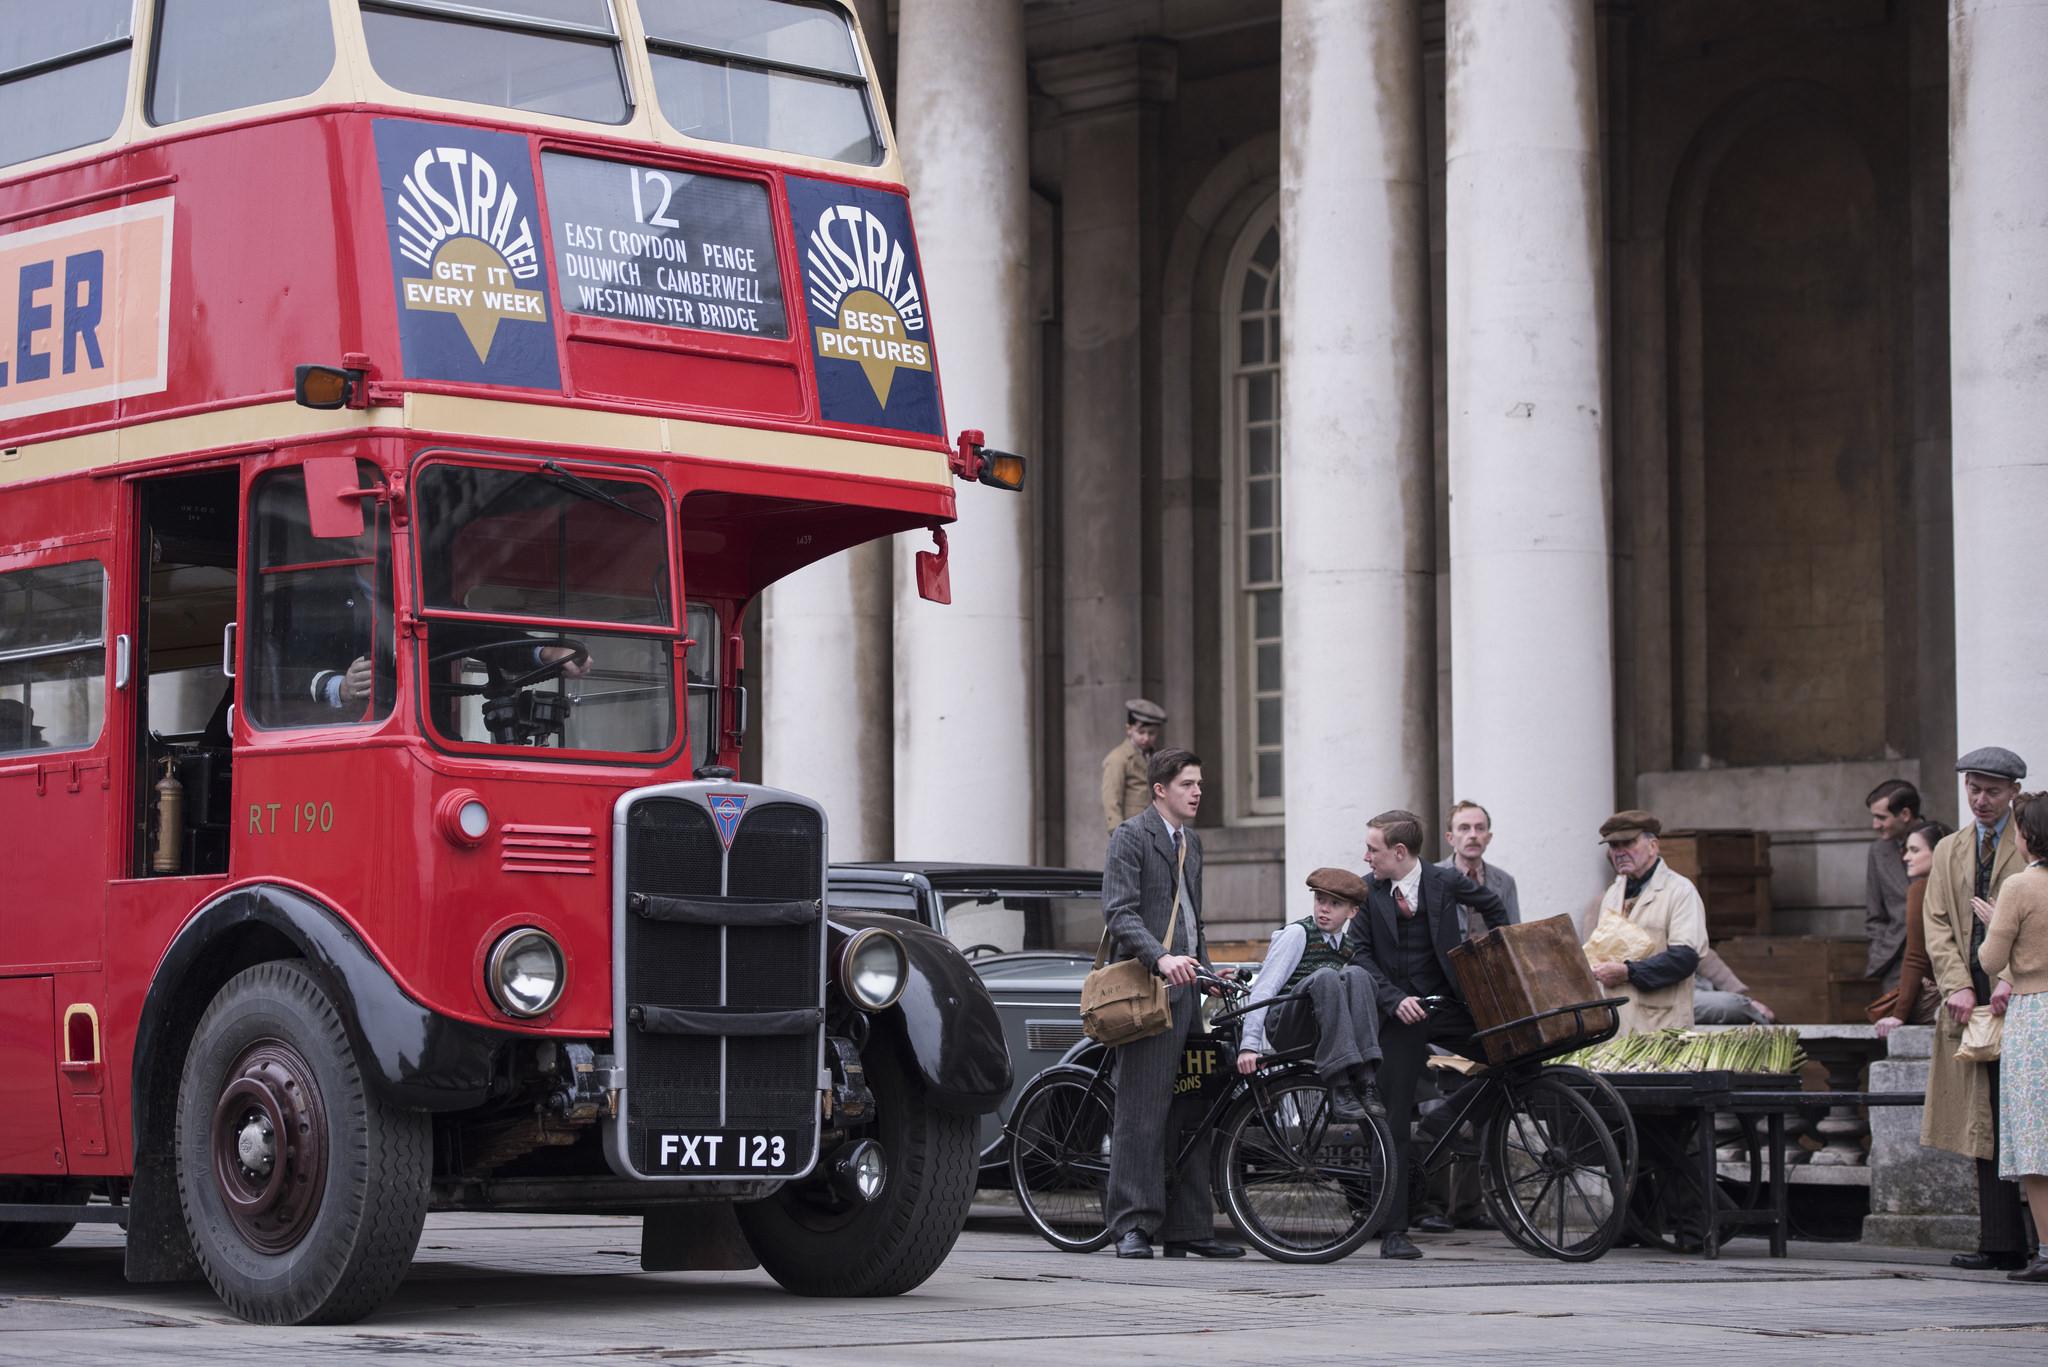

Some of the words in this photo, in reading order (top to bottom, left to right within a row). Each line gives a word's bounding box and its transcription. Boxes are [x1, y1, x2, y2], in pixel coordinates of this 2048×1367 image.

[398, 147, 538, 279] ILLUSTRATED
[630, 168, 680, 229] 12
[565, 222, 603, 251] EAST
[609, 229, 687, 263] CROYDON
[703, 243, 757, 272] PENGE
[436, 261, 476, 282] GET
[487, 266, 508, 286] IT
[566, 253, 641, 286] DULWICH
[657, 267, 763, 304] CAMBERWELL
[807, 205, 924, 331] ILLUSTRATED
[407, 283, 473, 307] EVERY
[483, 290, 542, 314] WEEK
[578, 285, 695, 323] WESTMINSTER
[699, 302, 760, 332] BRIDGE
[844, 310, 896, 335] BEST
[822, 332, 926, 365] PICTURES
[249, 803, 281, 834] RT
[294, 801, 334, 833] 190
[661, 1135, 723, 1166] FXT
[739, 1135, 786, 1168] 123
